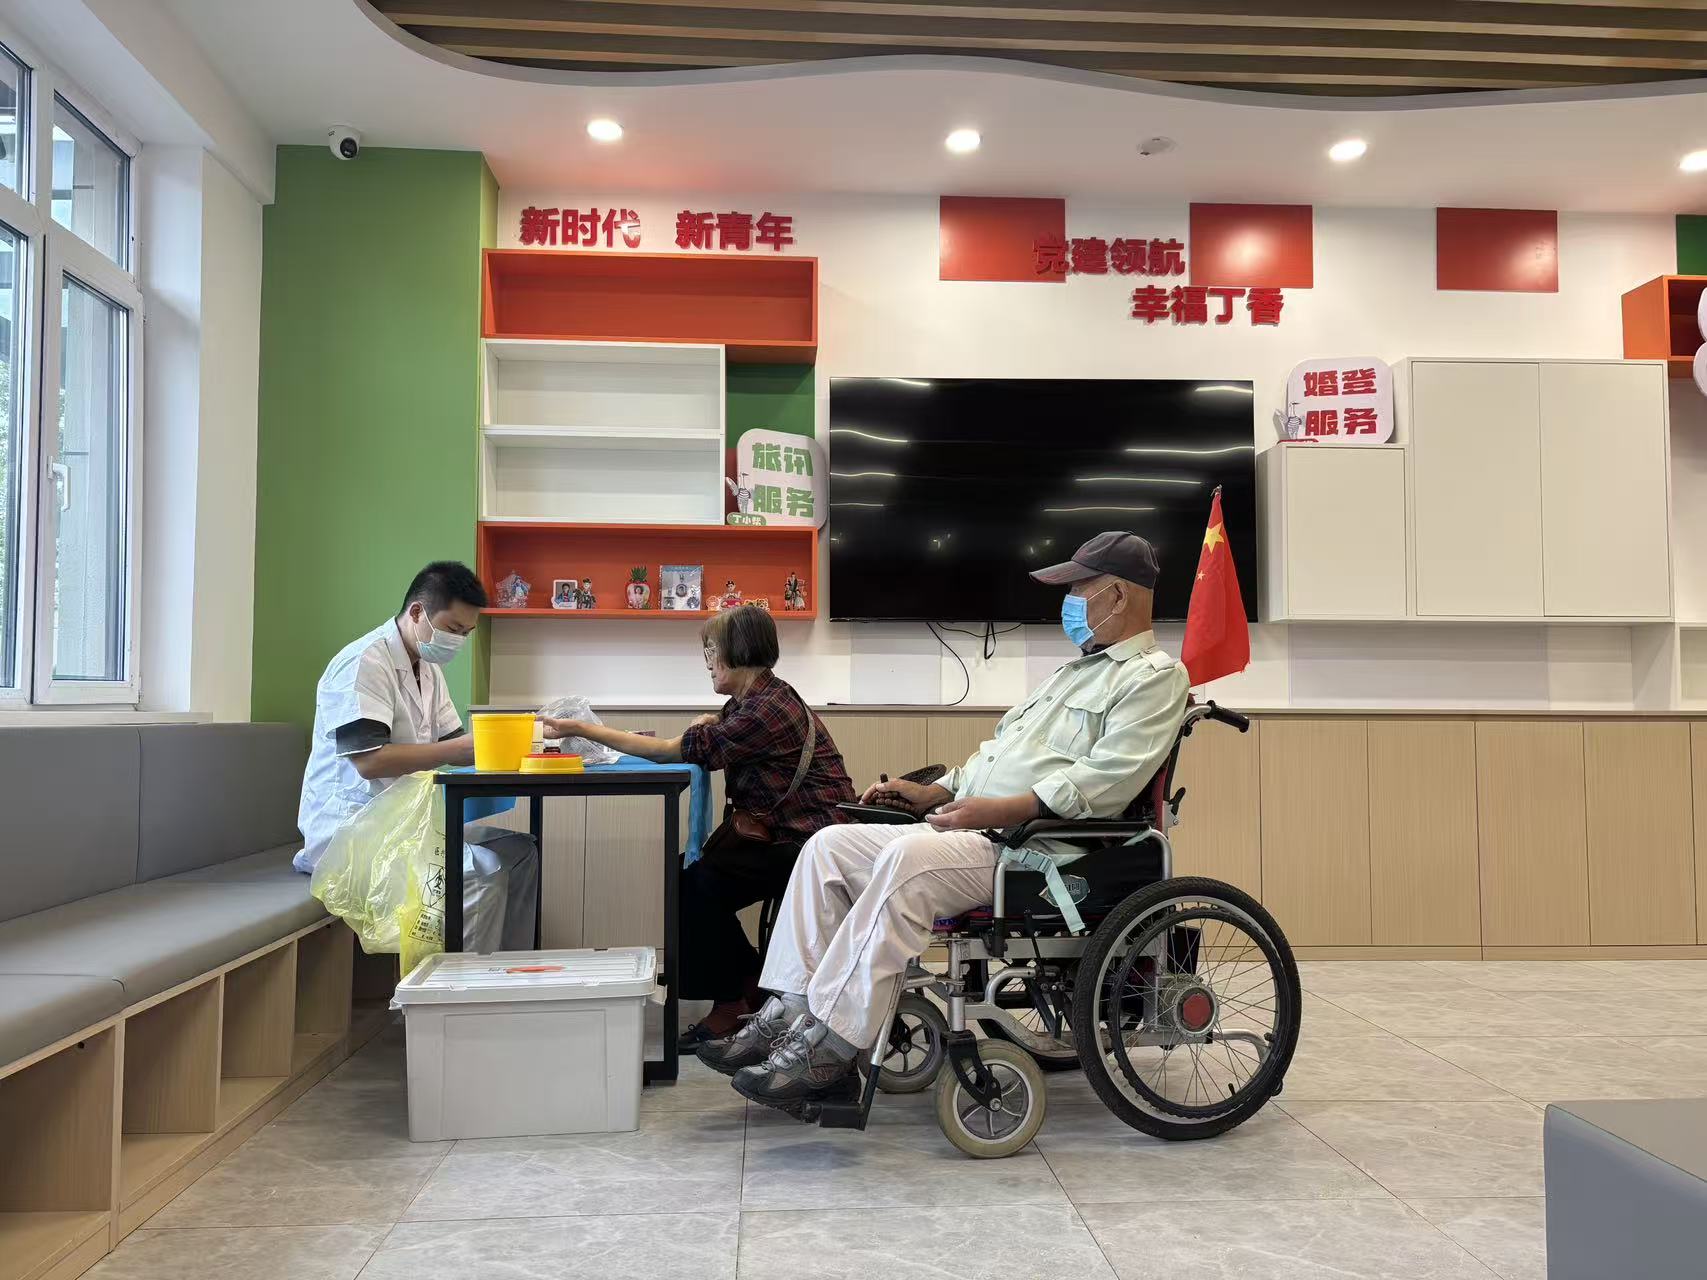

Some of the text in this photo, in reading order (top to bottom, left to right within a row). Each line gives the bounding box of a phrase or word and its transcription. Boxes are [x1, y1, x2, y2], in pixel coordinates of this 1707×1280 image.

[518, 206, 795, 251] 新时代 新青年
[1032, 232, 1186, 277] 党建领航
[1131, 284, 1285, 327] 幸福丁香
[1303, 367, 1377, 397] 婚登
[1304, 407, 1378, 437] 服务
[753, 484, 815, 518] 服务
